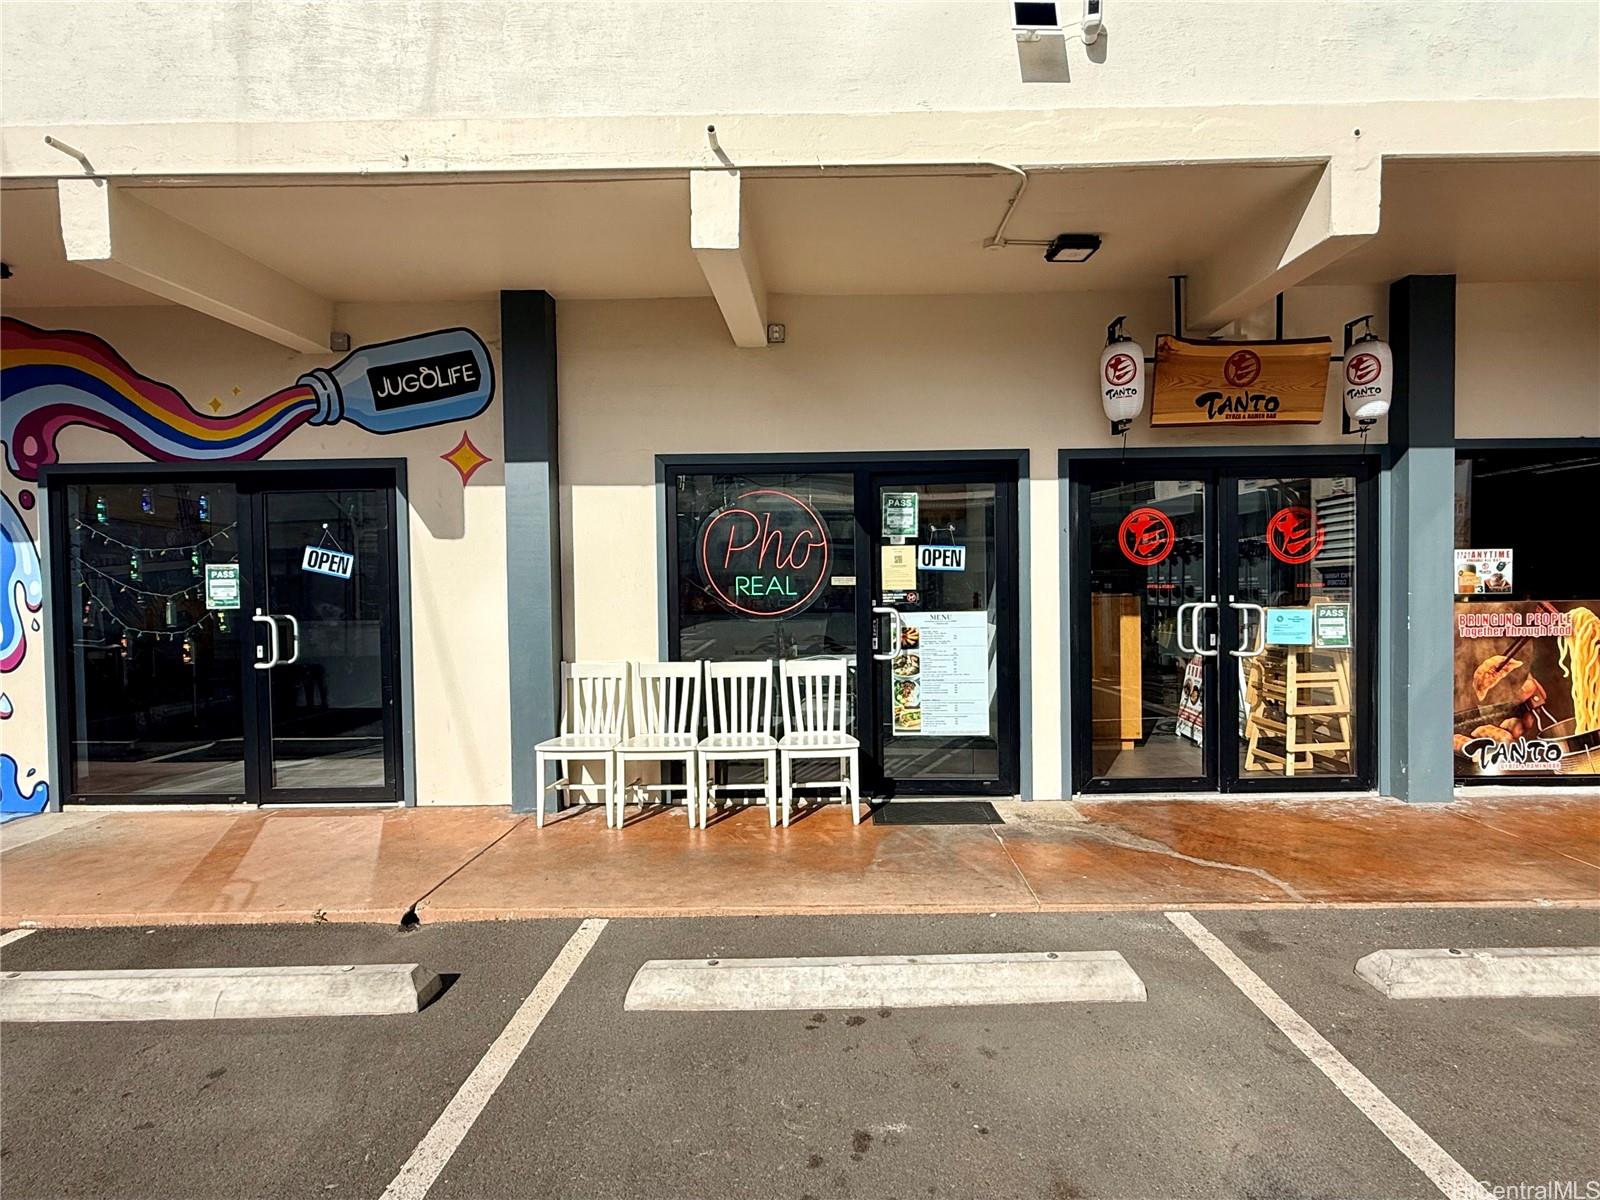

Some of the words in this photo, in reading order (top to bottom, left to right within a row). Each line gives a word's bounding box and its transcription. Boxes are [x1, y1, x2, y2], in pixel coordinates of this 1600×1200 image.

[1105, 387, 1138, 400] TANTO
[1347, 386, 1382, 400] TANTO
[1195, 390, 1280, 420] TANTO
[888, 499, 913, 508] PASS
[703, 508, 826, 569] Pho
[306, 549, 350, 575] OPEN
[922, 548, 962, 568] OPEN
[1471, 550, 1511, 559] ANYTIME
[211, 570, 235, 579] PASS
[735, 575, 798, 596] REAL
[929, 613, 953, 621] MENU
[1319, 609, 1344, 617] PASS
[1458, 613, 1523, 627] BRINGING
[1526, 611, 1573, 626] PEOPLE
[1459, 625, 1504, 638] Together
[1505, 625, 1547, 637] Through
[1547, 623, 1572, 636] Food
[1462, 736, 1563, 771] TANTO
